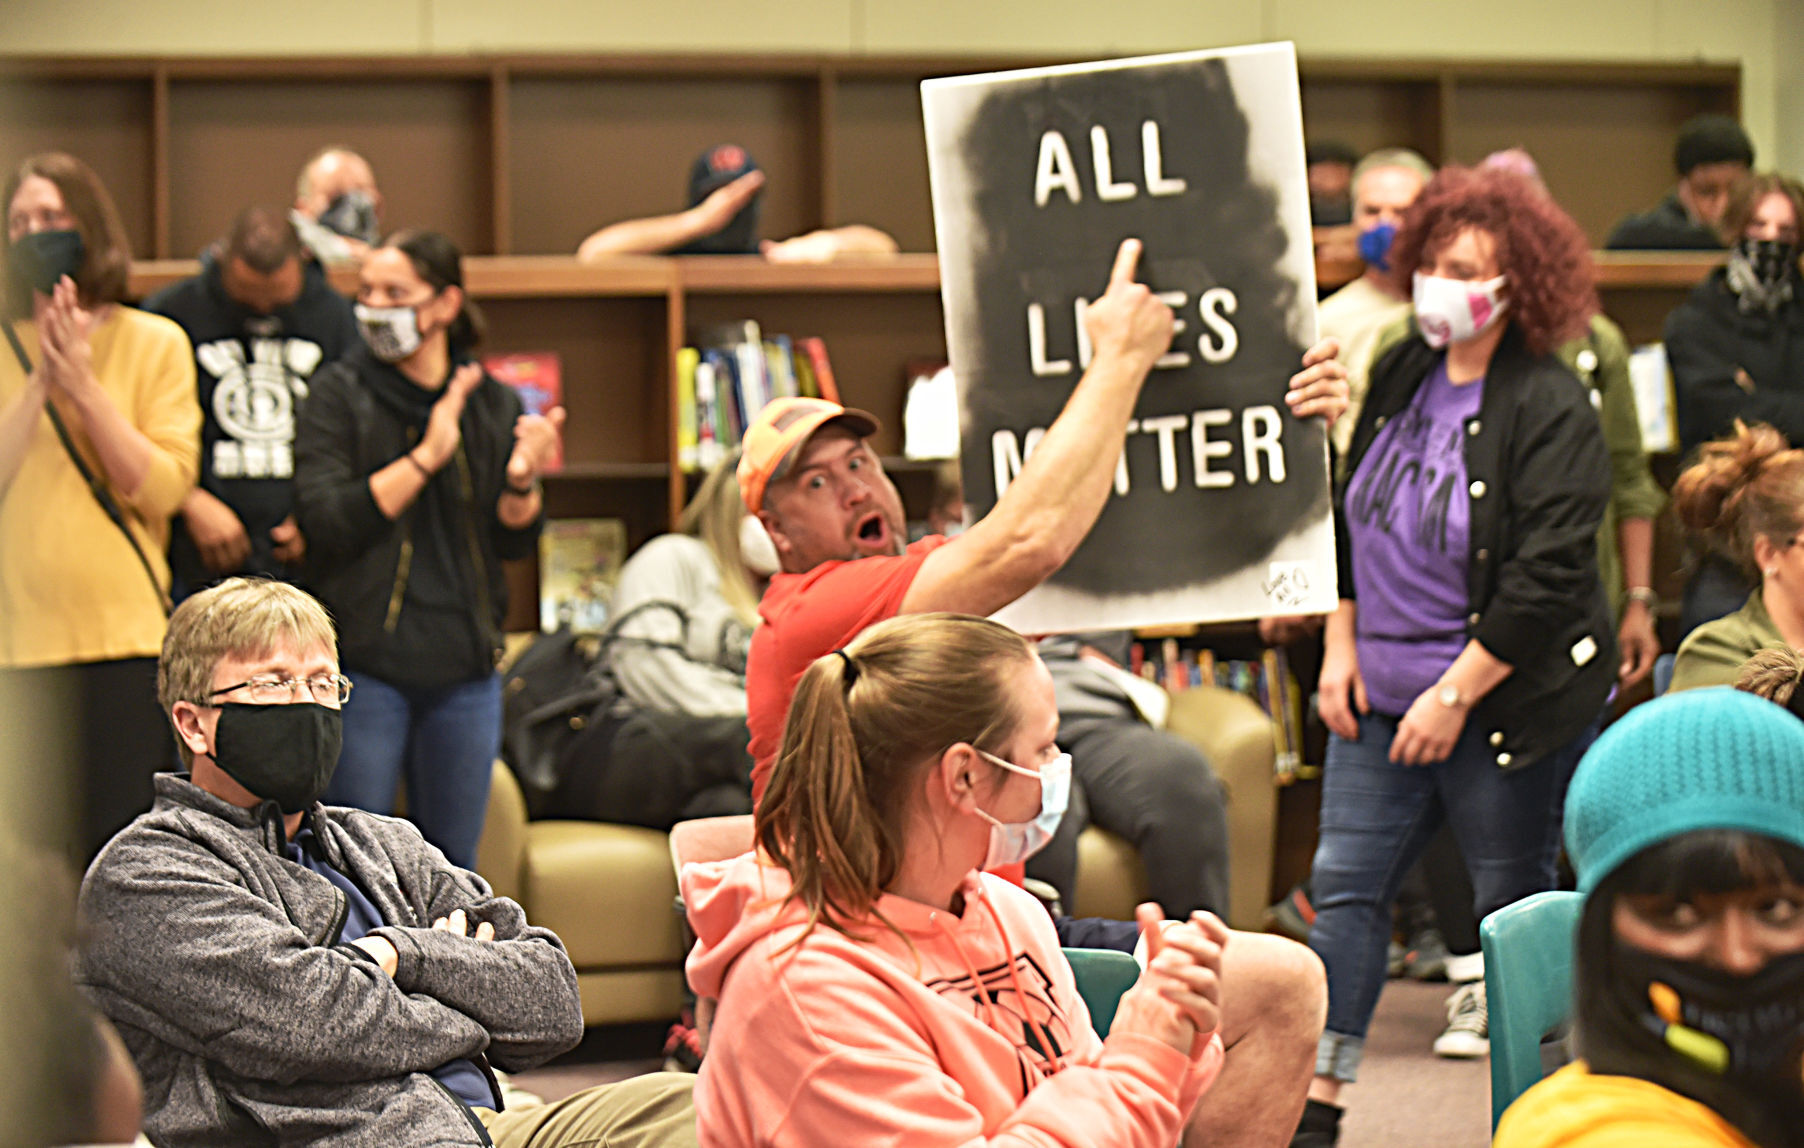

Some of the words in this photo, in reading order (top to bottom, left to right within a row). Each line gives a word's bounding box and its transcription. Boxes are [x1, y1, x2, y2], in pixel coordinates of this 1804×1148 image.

[1034, 120, 1187, 207] ALL
[1027, 287, 1239, 376] LIES
[991, 405, 1286, 500] MTTER
